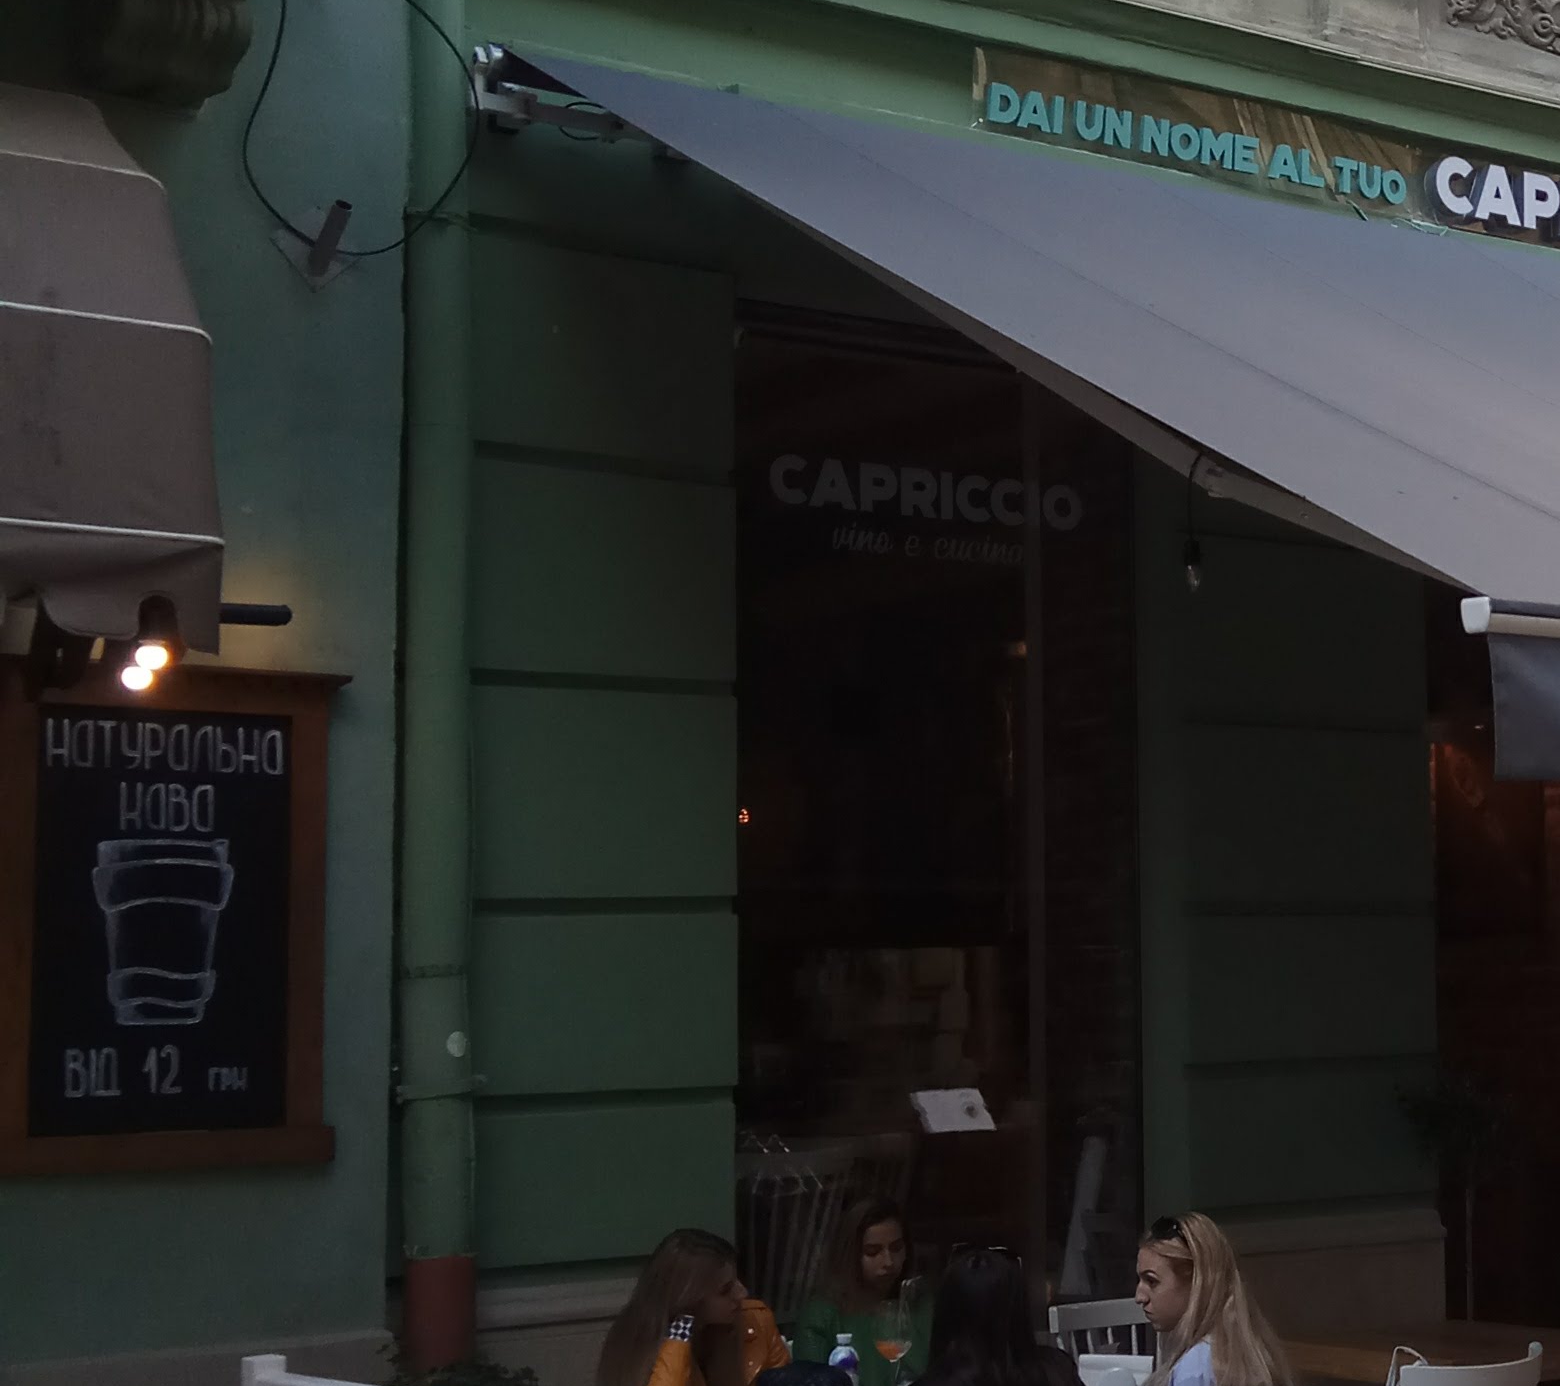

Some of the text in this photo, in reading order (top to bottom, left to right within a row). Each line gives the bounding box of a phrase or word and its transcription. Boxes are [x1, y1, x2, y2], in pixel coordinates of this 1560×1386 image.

[986, 81, 1064, 135] DAI
[1073, 98, 1133, 149] UN
[1140, 114, 1261, 175] NOME
[1267, 143, 1325, 188] AL
[1334, 155, 1408, 205] TUO
[769, 453, 1083, 531] CAPRICCIO
[832, 521, 1025, 566] vino e cucina
[46, 718, 285, 775] НАТУРАЛЬНА
[119, 781, 215, 832] КАВА
[64, 1047, 123, 1098] ВІД
[142, 1044, 182, 1095] 12
